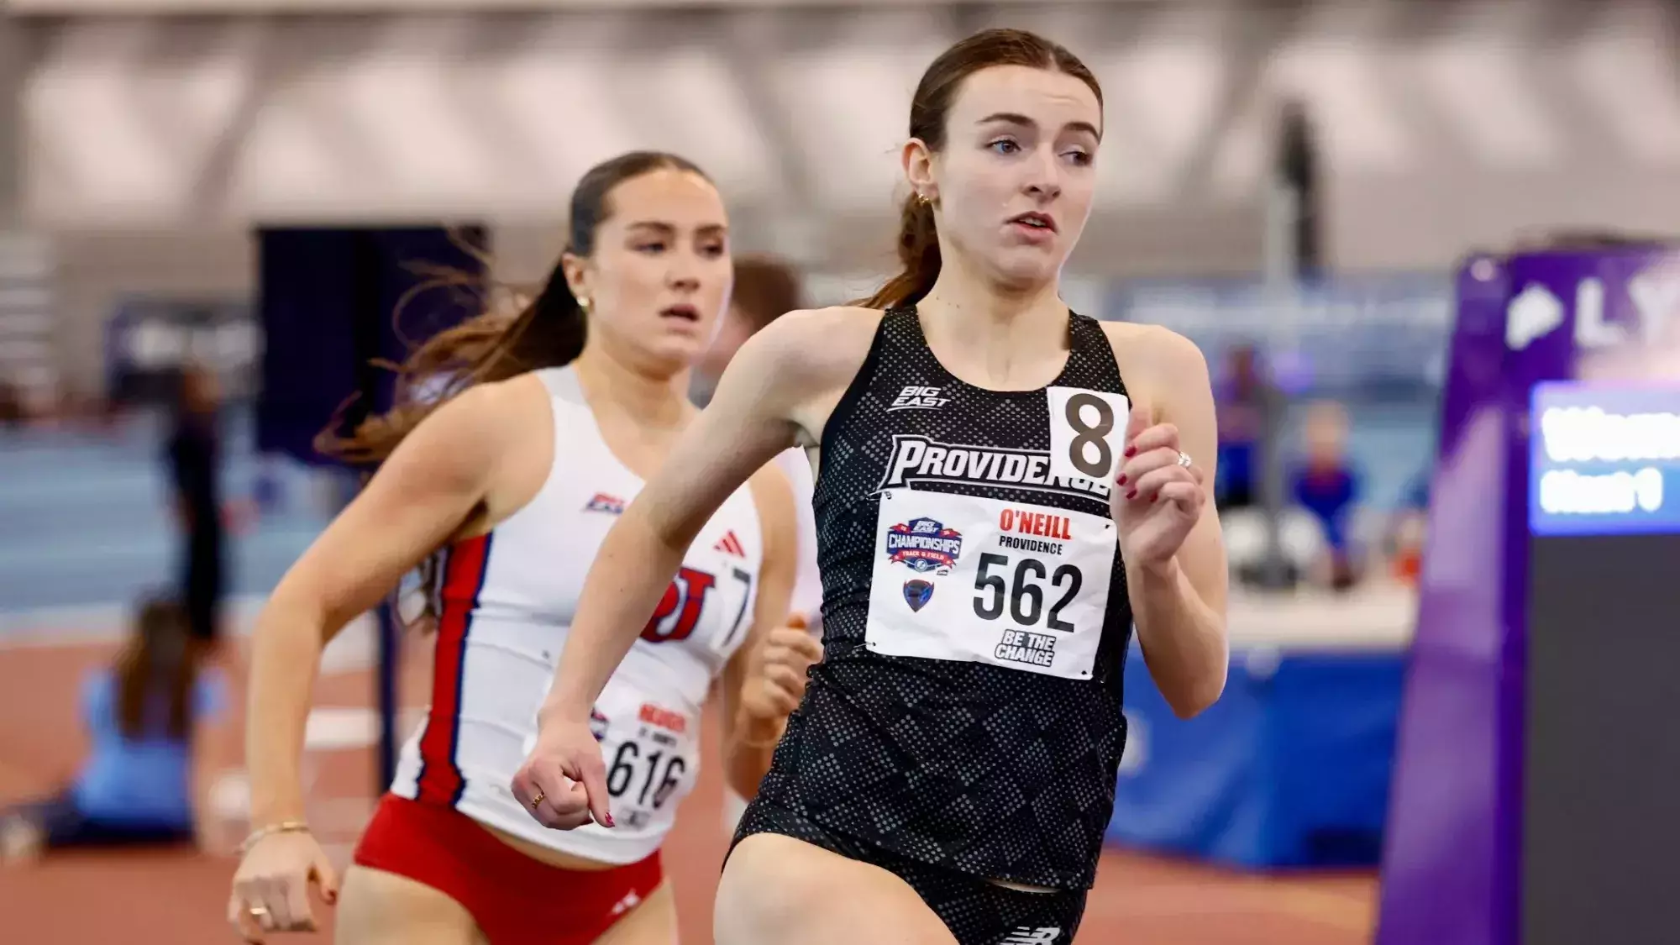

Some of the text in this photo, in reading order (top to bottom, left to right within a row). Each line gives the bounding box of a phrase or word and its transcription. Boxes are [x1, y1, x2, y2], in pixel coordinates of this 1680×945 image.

[891, 396, 951, 407] EAST
[899, 386, 941, 397] BIG
[1065, 393, 1115, 479] 8
[887, 440, 1110, 497] PROVIDE
[1000, 508, 1072, 540] O'NEILL
[888, 533, 960, 555] CHAMPIONSHIPS
[998, 536, 1063, 555] PROVIDENCE
[973, 552, 1083, 633] 562
[722, 566, 751, 648] 7
[1001, 629, 1056, 651] BE THE
[995, 643, 1055, 667] CHANGE
[607, 740, 685, 810] 616
